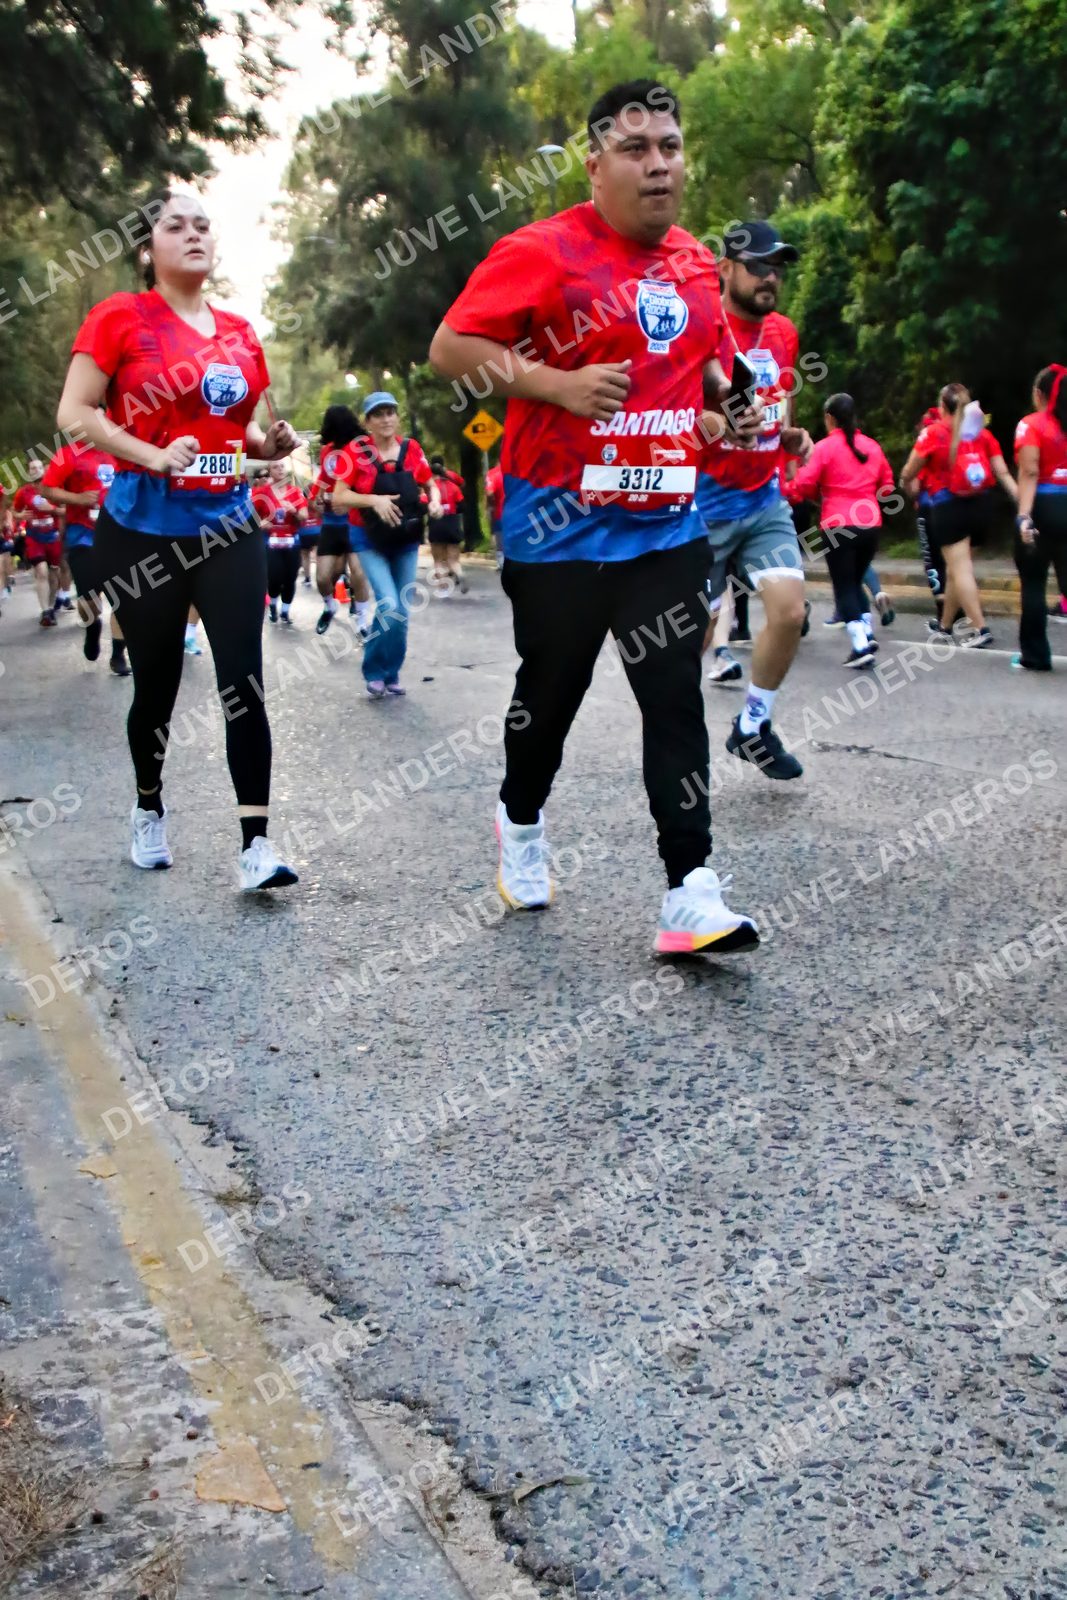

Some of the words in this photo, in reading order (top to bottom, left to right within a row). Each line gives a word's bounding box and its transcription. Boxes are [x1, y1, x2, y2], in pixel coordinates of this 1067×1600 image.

[644, 302, 668, 315] Race
[590, 407, 695, 436] SANTIAGO
[619, 468, 664, 490] 3312
